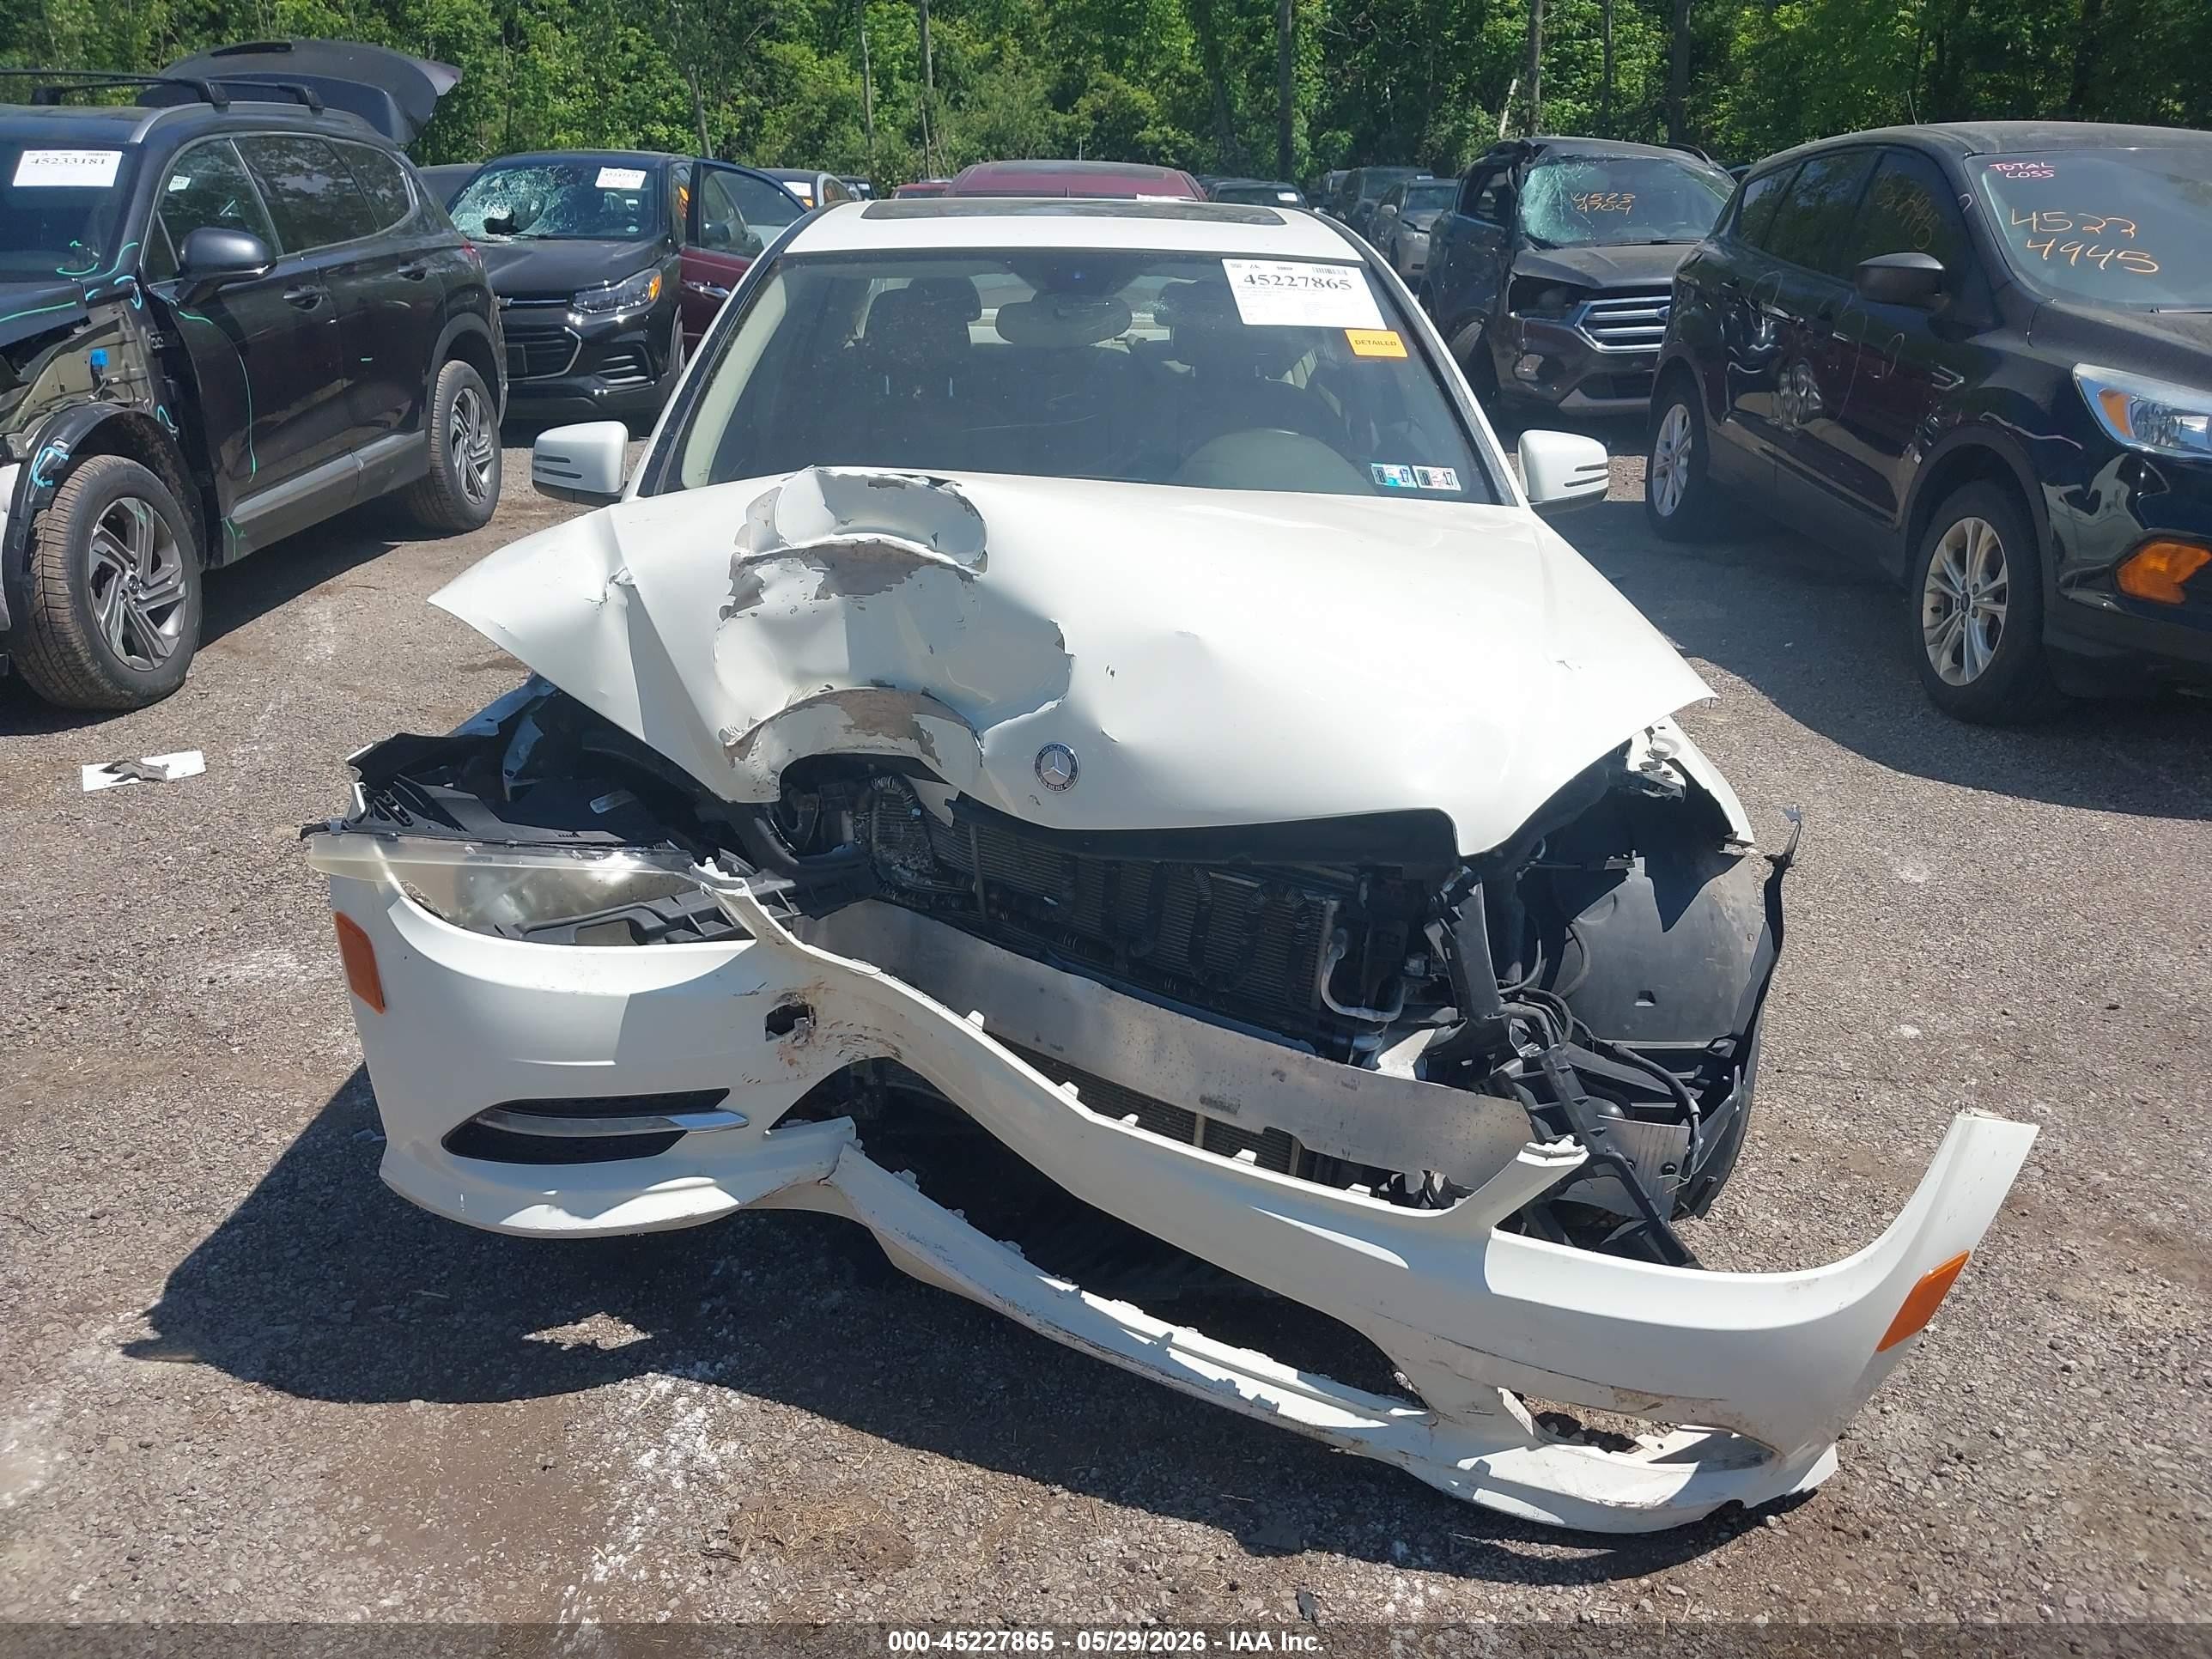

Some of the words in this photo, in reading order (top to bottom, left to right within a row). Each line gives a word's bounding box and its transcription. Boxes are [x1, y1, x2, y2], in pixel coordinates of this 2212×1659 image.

[1989, 161, 2055, 171] TOTAL
[2027, 238, 2160, 273] 4945
[1243, 274, 1352, 290] 45227865
[1400, 468, 1409, 483] 17
[1443, 471, 1454, 486] 17
